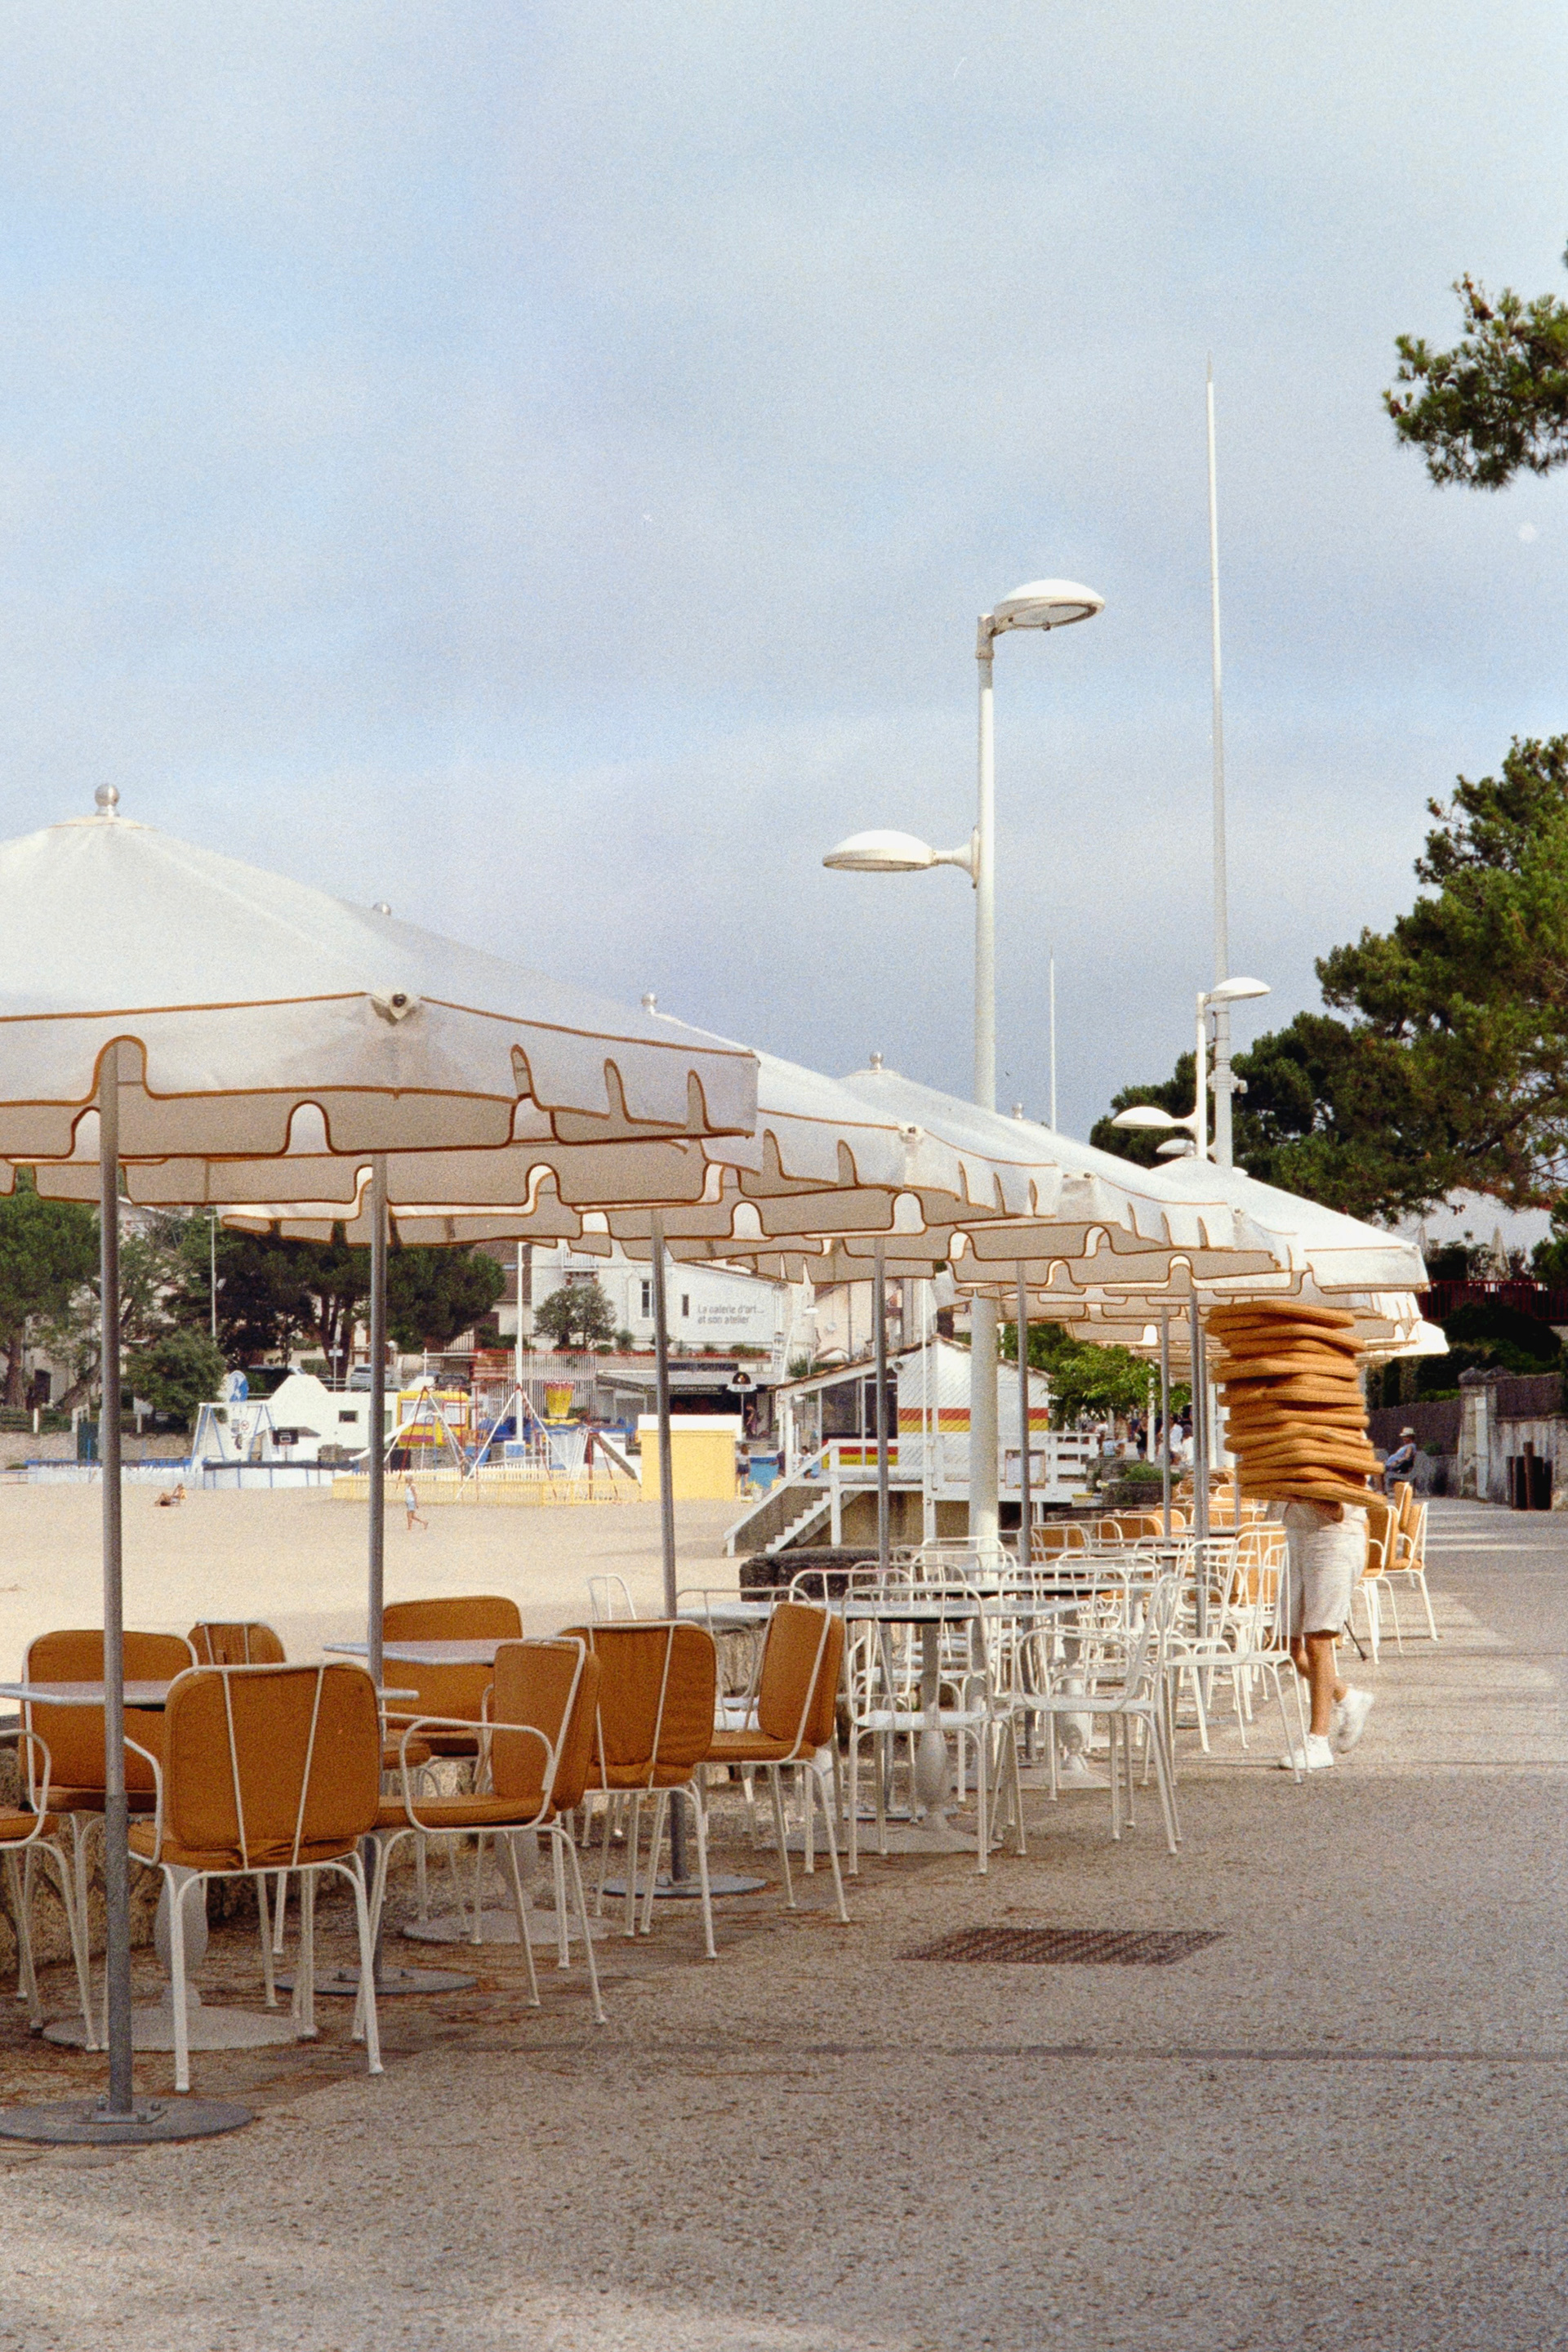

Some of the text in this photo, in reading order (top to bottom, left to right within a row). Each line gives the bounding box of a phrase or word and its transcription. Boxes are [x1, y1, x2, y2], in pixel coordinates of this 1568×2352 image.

[698, 1304, 707, 1314] La
[709, 1304, 736, 1315] galerie
[697, 1315, 750, 1324] et son atelier
